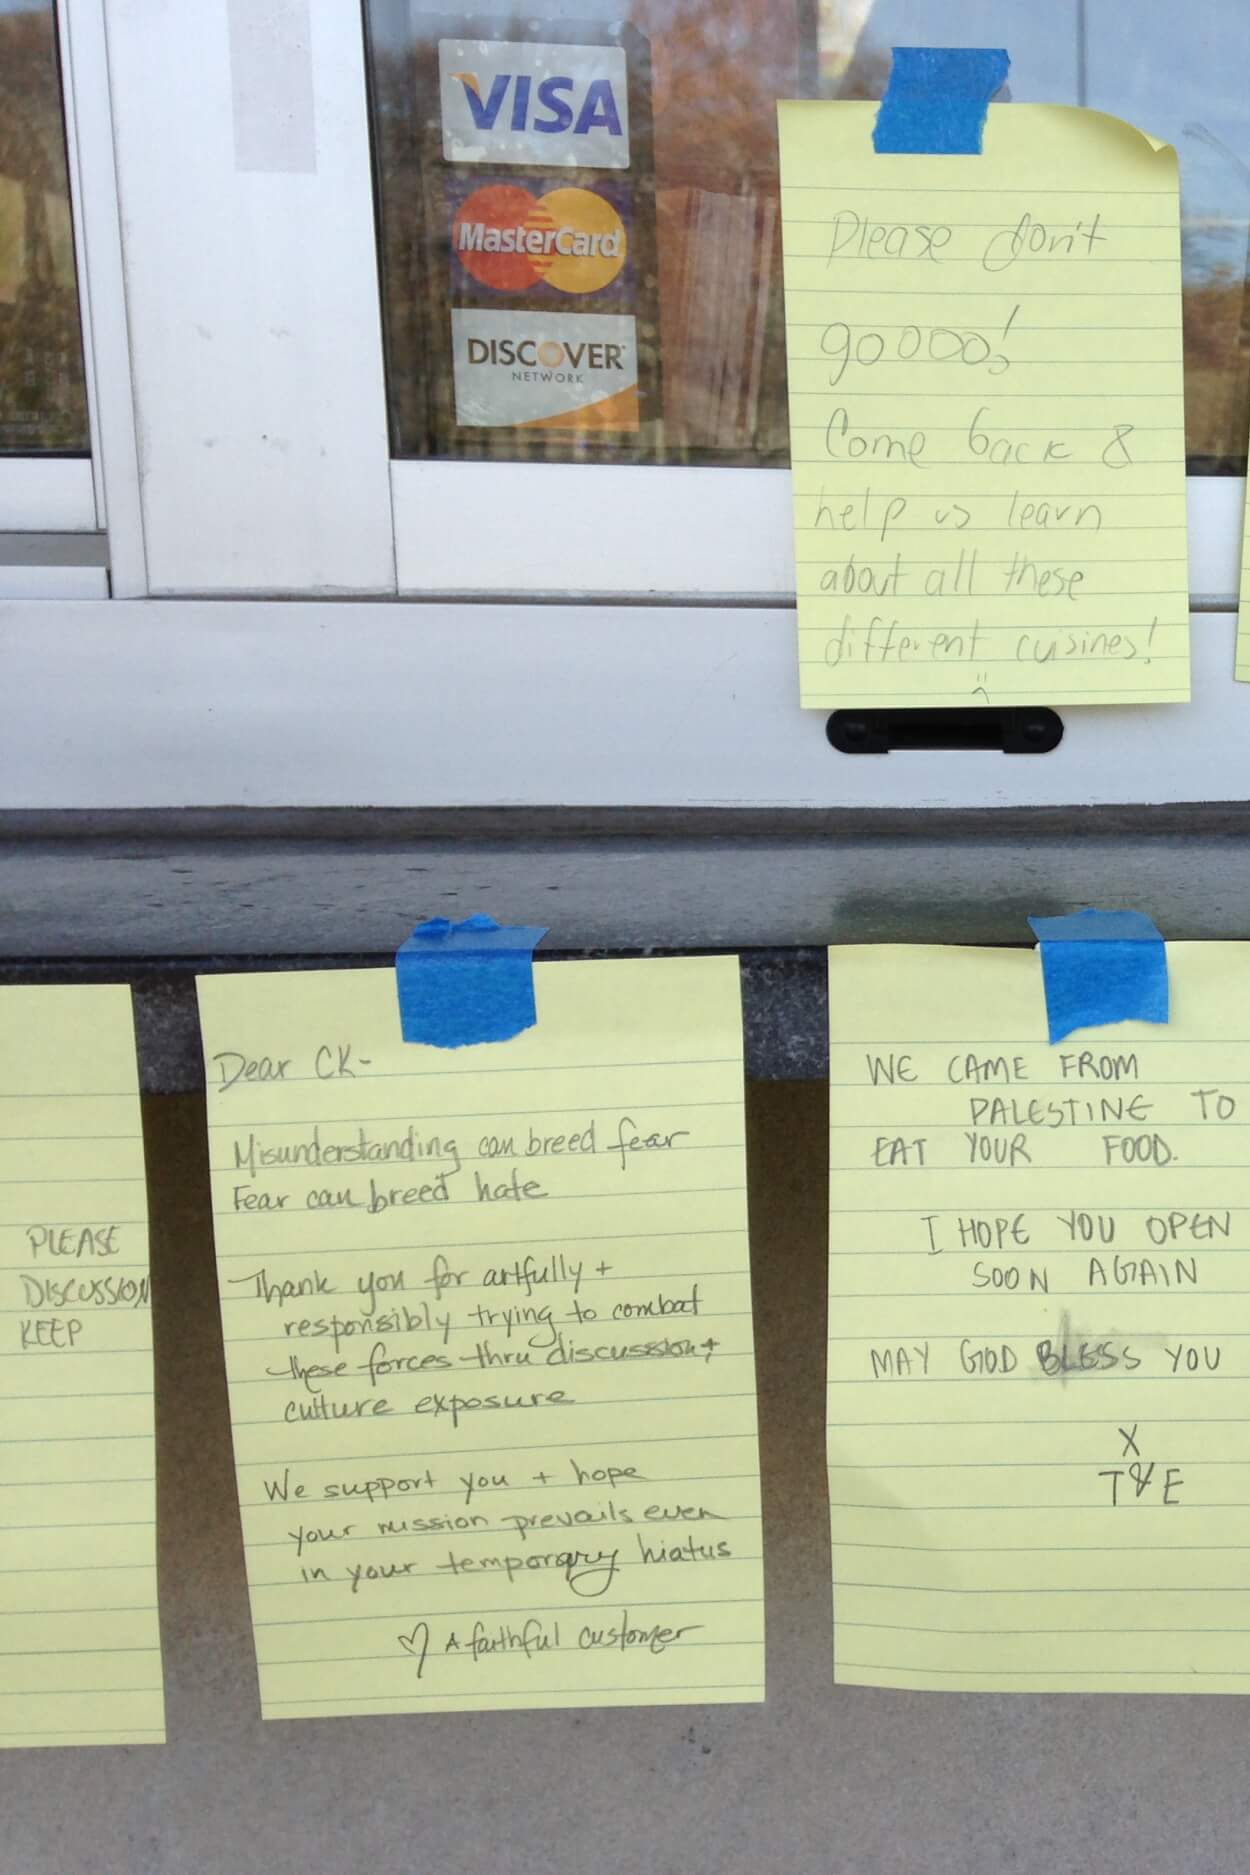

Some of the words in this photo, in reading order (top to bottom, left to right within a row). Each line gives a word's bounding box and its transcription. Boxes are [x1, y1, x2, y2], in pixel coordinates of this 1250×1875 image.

[446, 71, 624, 137] VISA
[458, 221, 622, 258] MasterCard
[826, 209, 952, 270] Please
[981, 212, 1108, 272] don't
[467, 337, 625, 370] DISCOVER
[510, 371, 585, 384] NETWORK
[825, 407, 931, 470] Come
[967, 405, 1074, 466] back
[814, 485, 908, 543] help
[934, 502, 971, 528] us
[1006, 489, 1103, 532] learn
[819, 552, 910, 598] about
[923, 547, 978, 596] all
[1003, 550, 1086, 601] these
[823, 613, 991, 668] different
[1015, 616, 1159, 665] cuisines!
[213, 1051, 292, 1093] Dear
[866, 1053, 919, 1086] WE
[947, 1053, 1030, 1086] CAME
[1058, 1051, 1139, 1081] FROM
[969, 1094, 1154, 1129] PALESTINE
[1190, 1089, 1236, 1122] TO
[232, 1125, 463, 1179] Misunderstanding
[478, 1129, 521, 1157] can
[524, 1118, 596, 1156] breed
[606, 1116, 691, 1171] fear
[869, 1136, 928, 1167] EAT
[964, 1130, 1033, 1167] YOUR
[1102, 1133, 1179, 1167] FOOD.
[232, 1185, 292, 1212] Fear
[305, 1184, 364, 1211] can
[367, 1167, 451, 1215] breed
[473, 1166, 550, 1202] hate
[25, 1224, 121, 1260] PLEASE
[920, 1215, 944, 1255] I
[957, 1213, 1031, 1250] HOPE
[1056, 1209, 1115, 1243] YOU
[1145, 1210, 1232, 1245] OPEN
[19, 1273, 150, 1309] DISCUSSION
[227, 1263, 339, 1308] Thank
[356, 1270, 405, 1316] you
[423, 1254, 470, 1301] for
[482, 1254, 584, 1295] artfully
[971, 1261, 1050, 1294] SOON
[1088, 1255, 1198, 1288] AGAIN
[19, 1317, 83, 1350] KEEP
[283, 1300, 452, 1354] responsibly
[467, 1300, 558, 1348] trying
[571, 1298, 599, 1323] to
[611, 1283, 705, 1321] combat
[265, 1354, 348, 1394] these
[357, 1341, 453, 1387] forces
[459, 1342, 531, 1370] thru
[869, 1341, 929, 1379] MAY
[959, 1338, 1018, 1375] GOD
[1035, 1339, 1143, 1377] BLESS
[1164, 1342, 1221, 1374] YOU
[283, 1391, 395, 1424] culture
[413, 1388, 577, 1429] exposure
[1117, 1423, 1141, 1458] X
[263, 1467, 309, 1502] We
[323, 1469, 439, 1502] support
[459, 1471, 509, 1505] you
[570, 1458, 649, 1493] hope
[287, 1523, 357, 1557] your
[377, 1513, 489, 1536] mission
[500, 1500, 634, 1540] prevails
[642, 1503, 729, 1523] even
[300, 1564, 331, 1584] in
[346, 1560, 419, 1594] your
[435, 1546, 622, 1598] temporary
[635, 1533, 733, 1565] hiatus
[444, 1632, 462, 1652] A
[464, 1618, 561, 1663] faithful
[578, 1609, 706, 1655] customer
